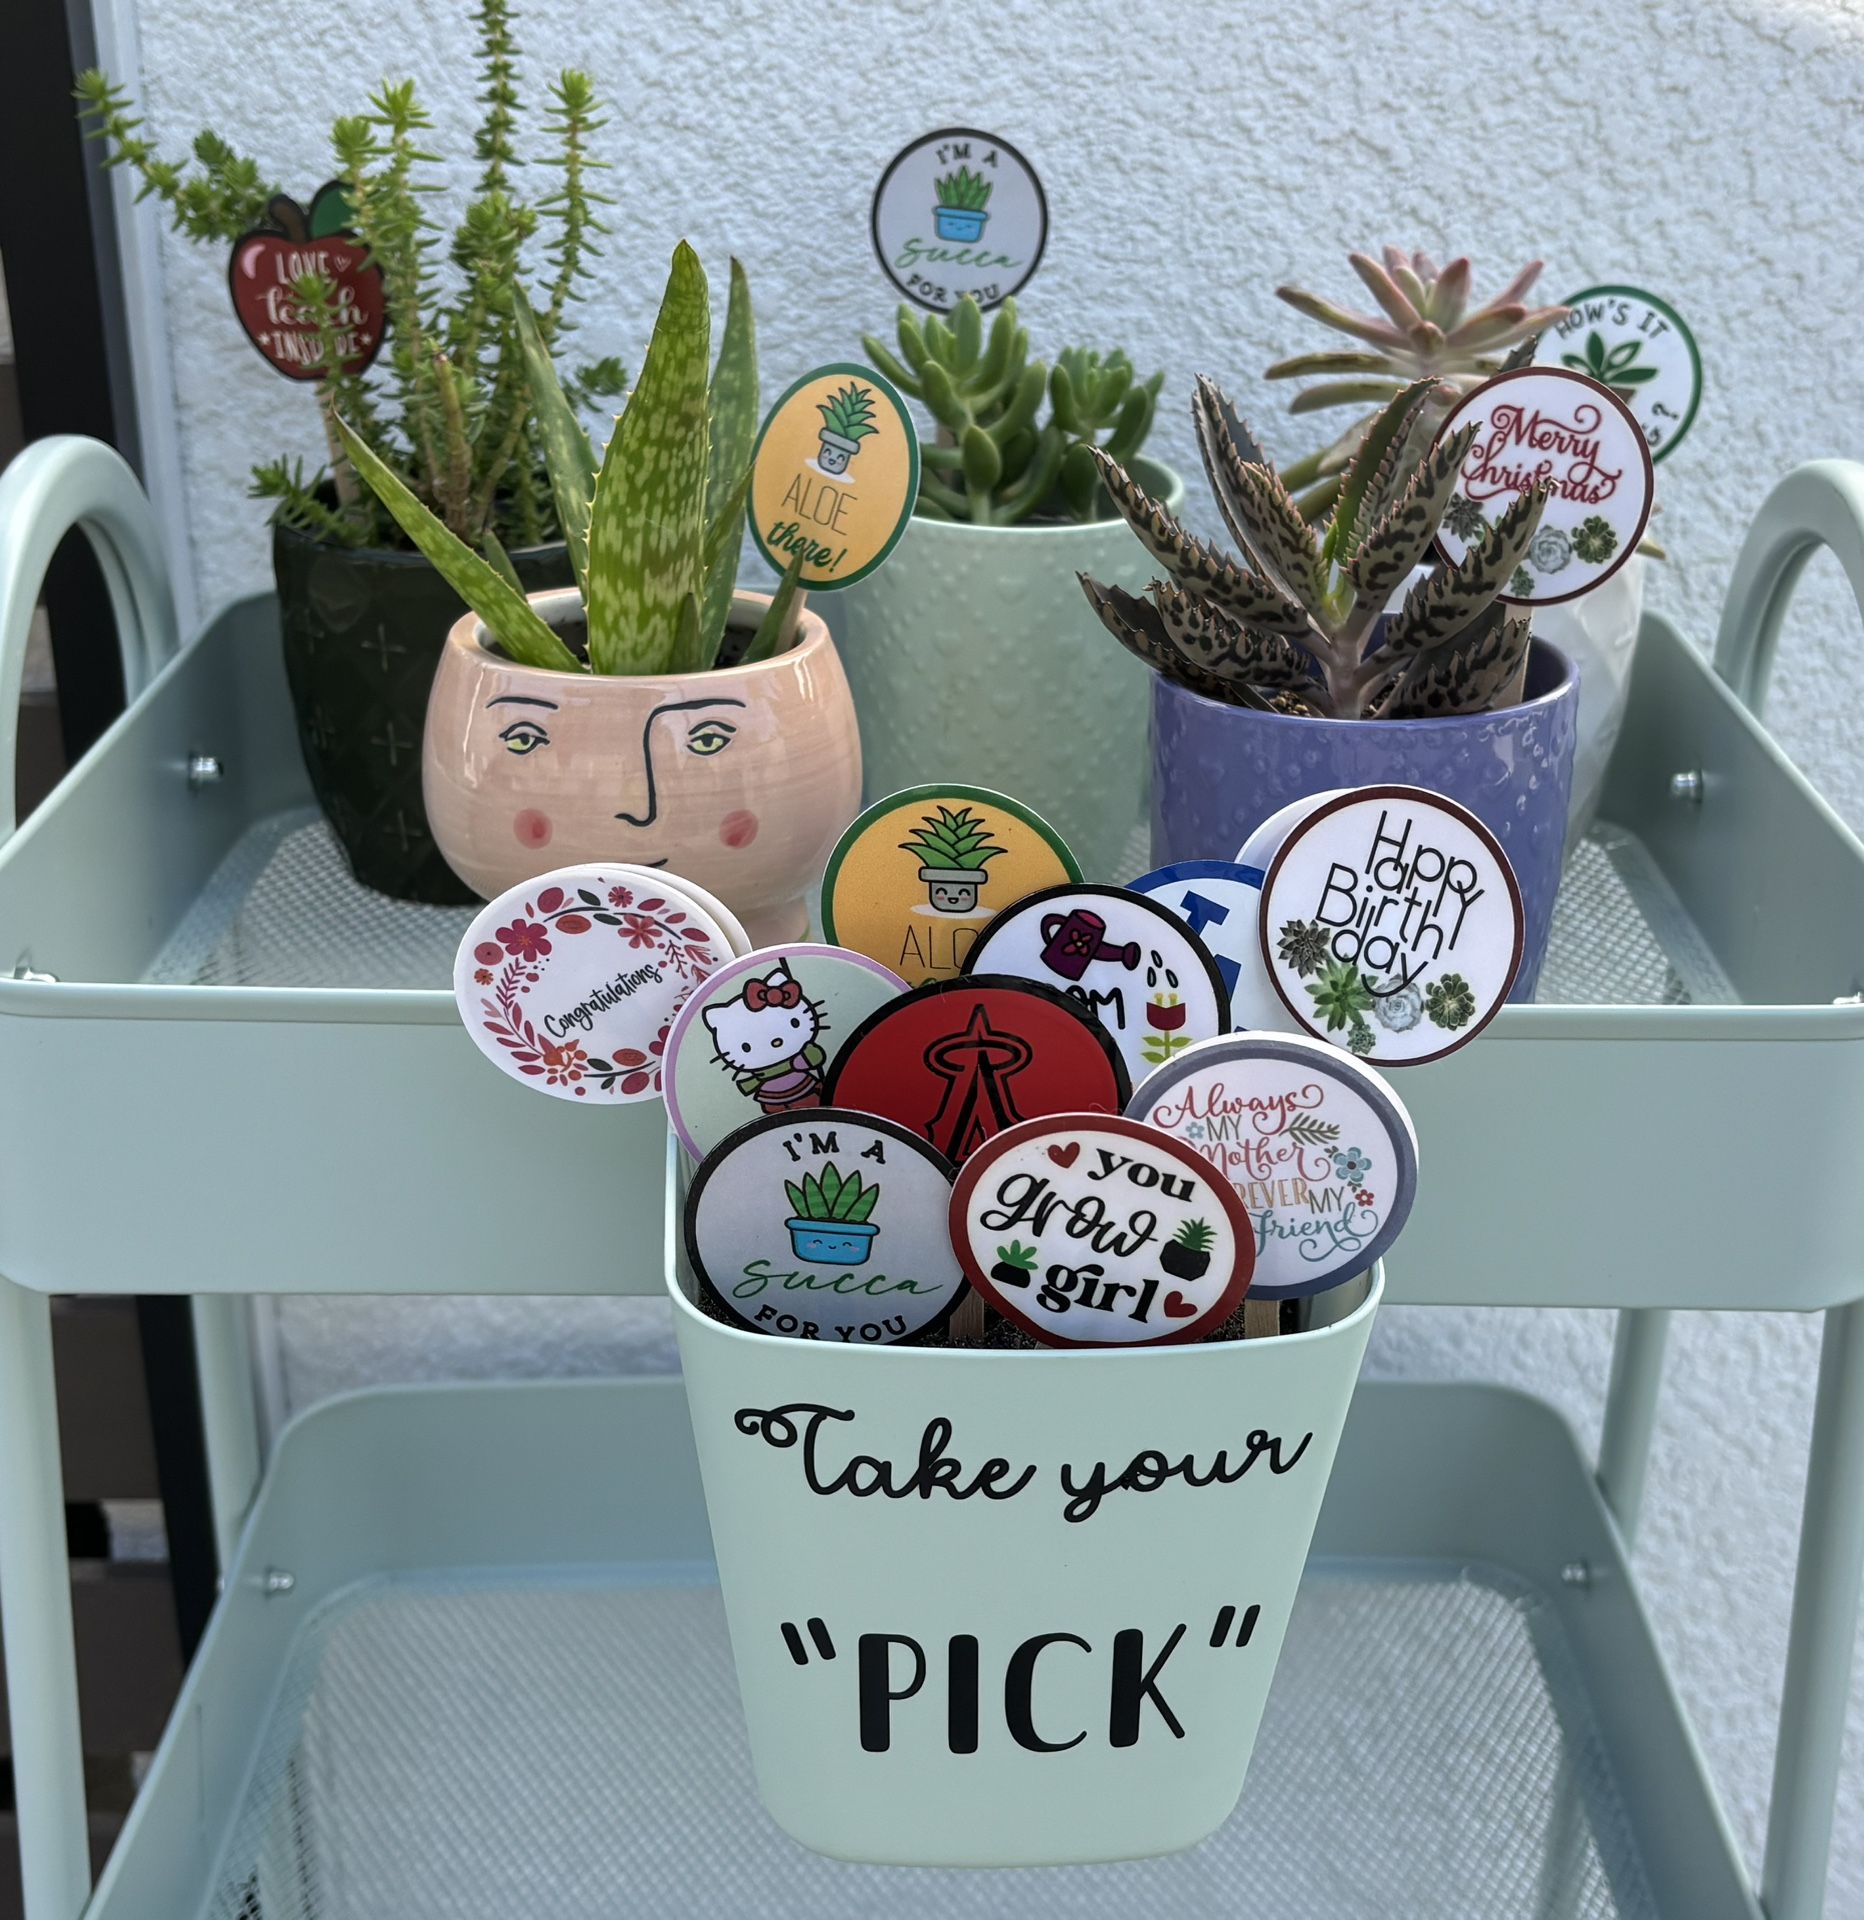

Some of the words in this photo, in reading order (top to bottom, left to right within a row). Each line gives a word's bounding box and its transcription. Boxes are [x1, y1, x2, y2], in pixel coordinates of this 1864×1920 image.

[936, 143, 970, 165] I'M
[982, 150, 998, 168] A
[907, 274, 947, 302] FOR
[1555, 299, 1632, 340] HOW'S
[1637, 310, 1671, 339] IT
[1491, 404, 1622, 486] Merry
[781, 473, 858, 536] ALOE
[767, 521, 847, 573] there!
[900, 924, 979, 970] ALO
[544, 962, 663, 1038] Congratulations
[1153, 1083, 1324, 1135] Always
[1206, 1114, 1243, 1142] MY
[782, 1131, 840, 1162] I'M
[860, 1140, 886, 1165] A
[1087, 1148, 1196, 1203] you
[1308, 1186, 1345, 1215] MY
[980, 1173, 1159, 1258] grow
[1036, 1264, 1160, 1323] girl
[754, 1303, 820, 1340] FOR
[835, 1314, 908, 1342] YOU
[734, 1402, 1037, 1501] Take
[1060, 1428, 1314, 1524] your
[780, 1603, 1262, 1755] "PICK"
